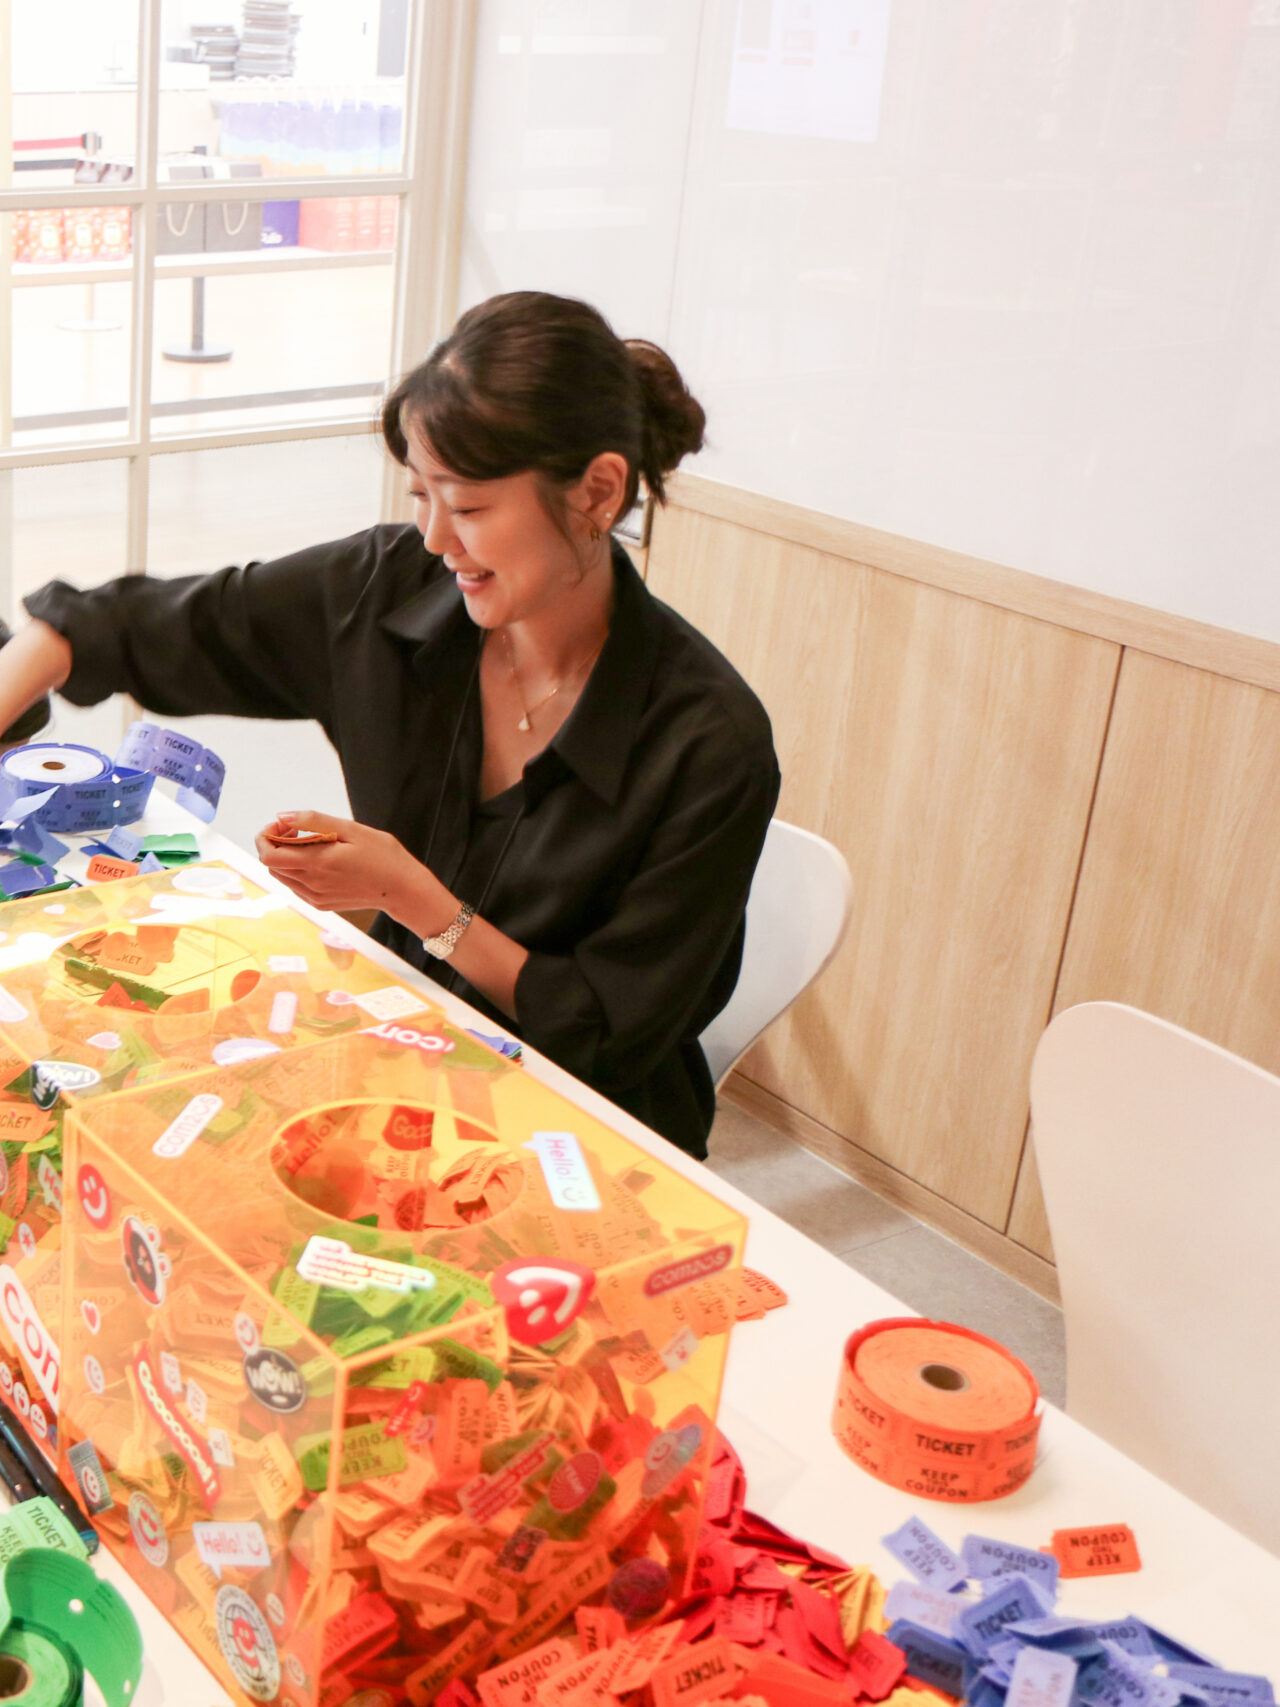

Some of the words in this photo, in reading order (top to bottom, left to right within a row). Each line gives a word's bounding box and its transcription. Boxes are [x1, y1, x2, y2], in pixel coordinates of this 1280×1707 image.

[164, 736, 195, 756] TICKET
[153, 765, 186, 782] COUPON
[74, 789, 107, 800] TICKET
[93, 863, 126, 878] TICKET
[545, 1138, 580, 1181] Hello!
[245, 1359, 302, 1395] WOW!
[915, 1433, 977, 1457] TICKET
[921, 1467, 960, 1481] KEEP
[905, 1478, 969, 1498] COUPON
[26, 1506, 67, 1550] TICKET
[1069, 1532, 1128, 1548] COUPON
[200, 1530, 245, 1555] Hello!
[910, 1526, 957, 1572] COUPON
[903, 1548, 935, 1577] KEEP
[981, 1544, 1049, 1571] COUPON
[1085, 1553, 1122, 1568] KEEP
[508, 1600, 559, 1647] TICKET
[973, 1599, 1023, 1639] TICKET
[496, 1650, 562, 1689] COUPON
[675, 1655, 727, 1695] TICKET
